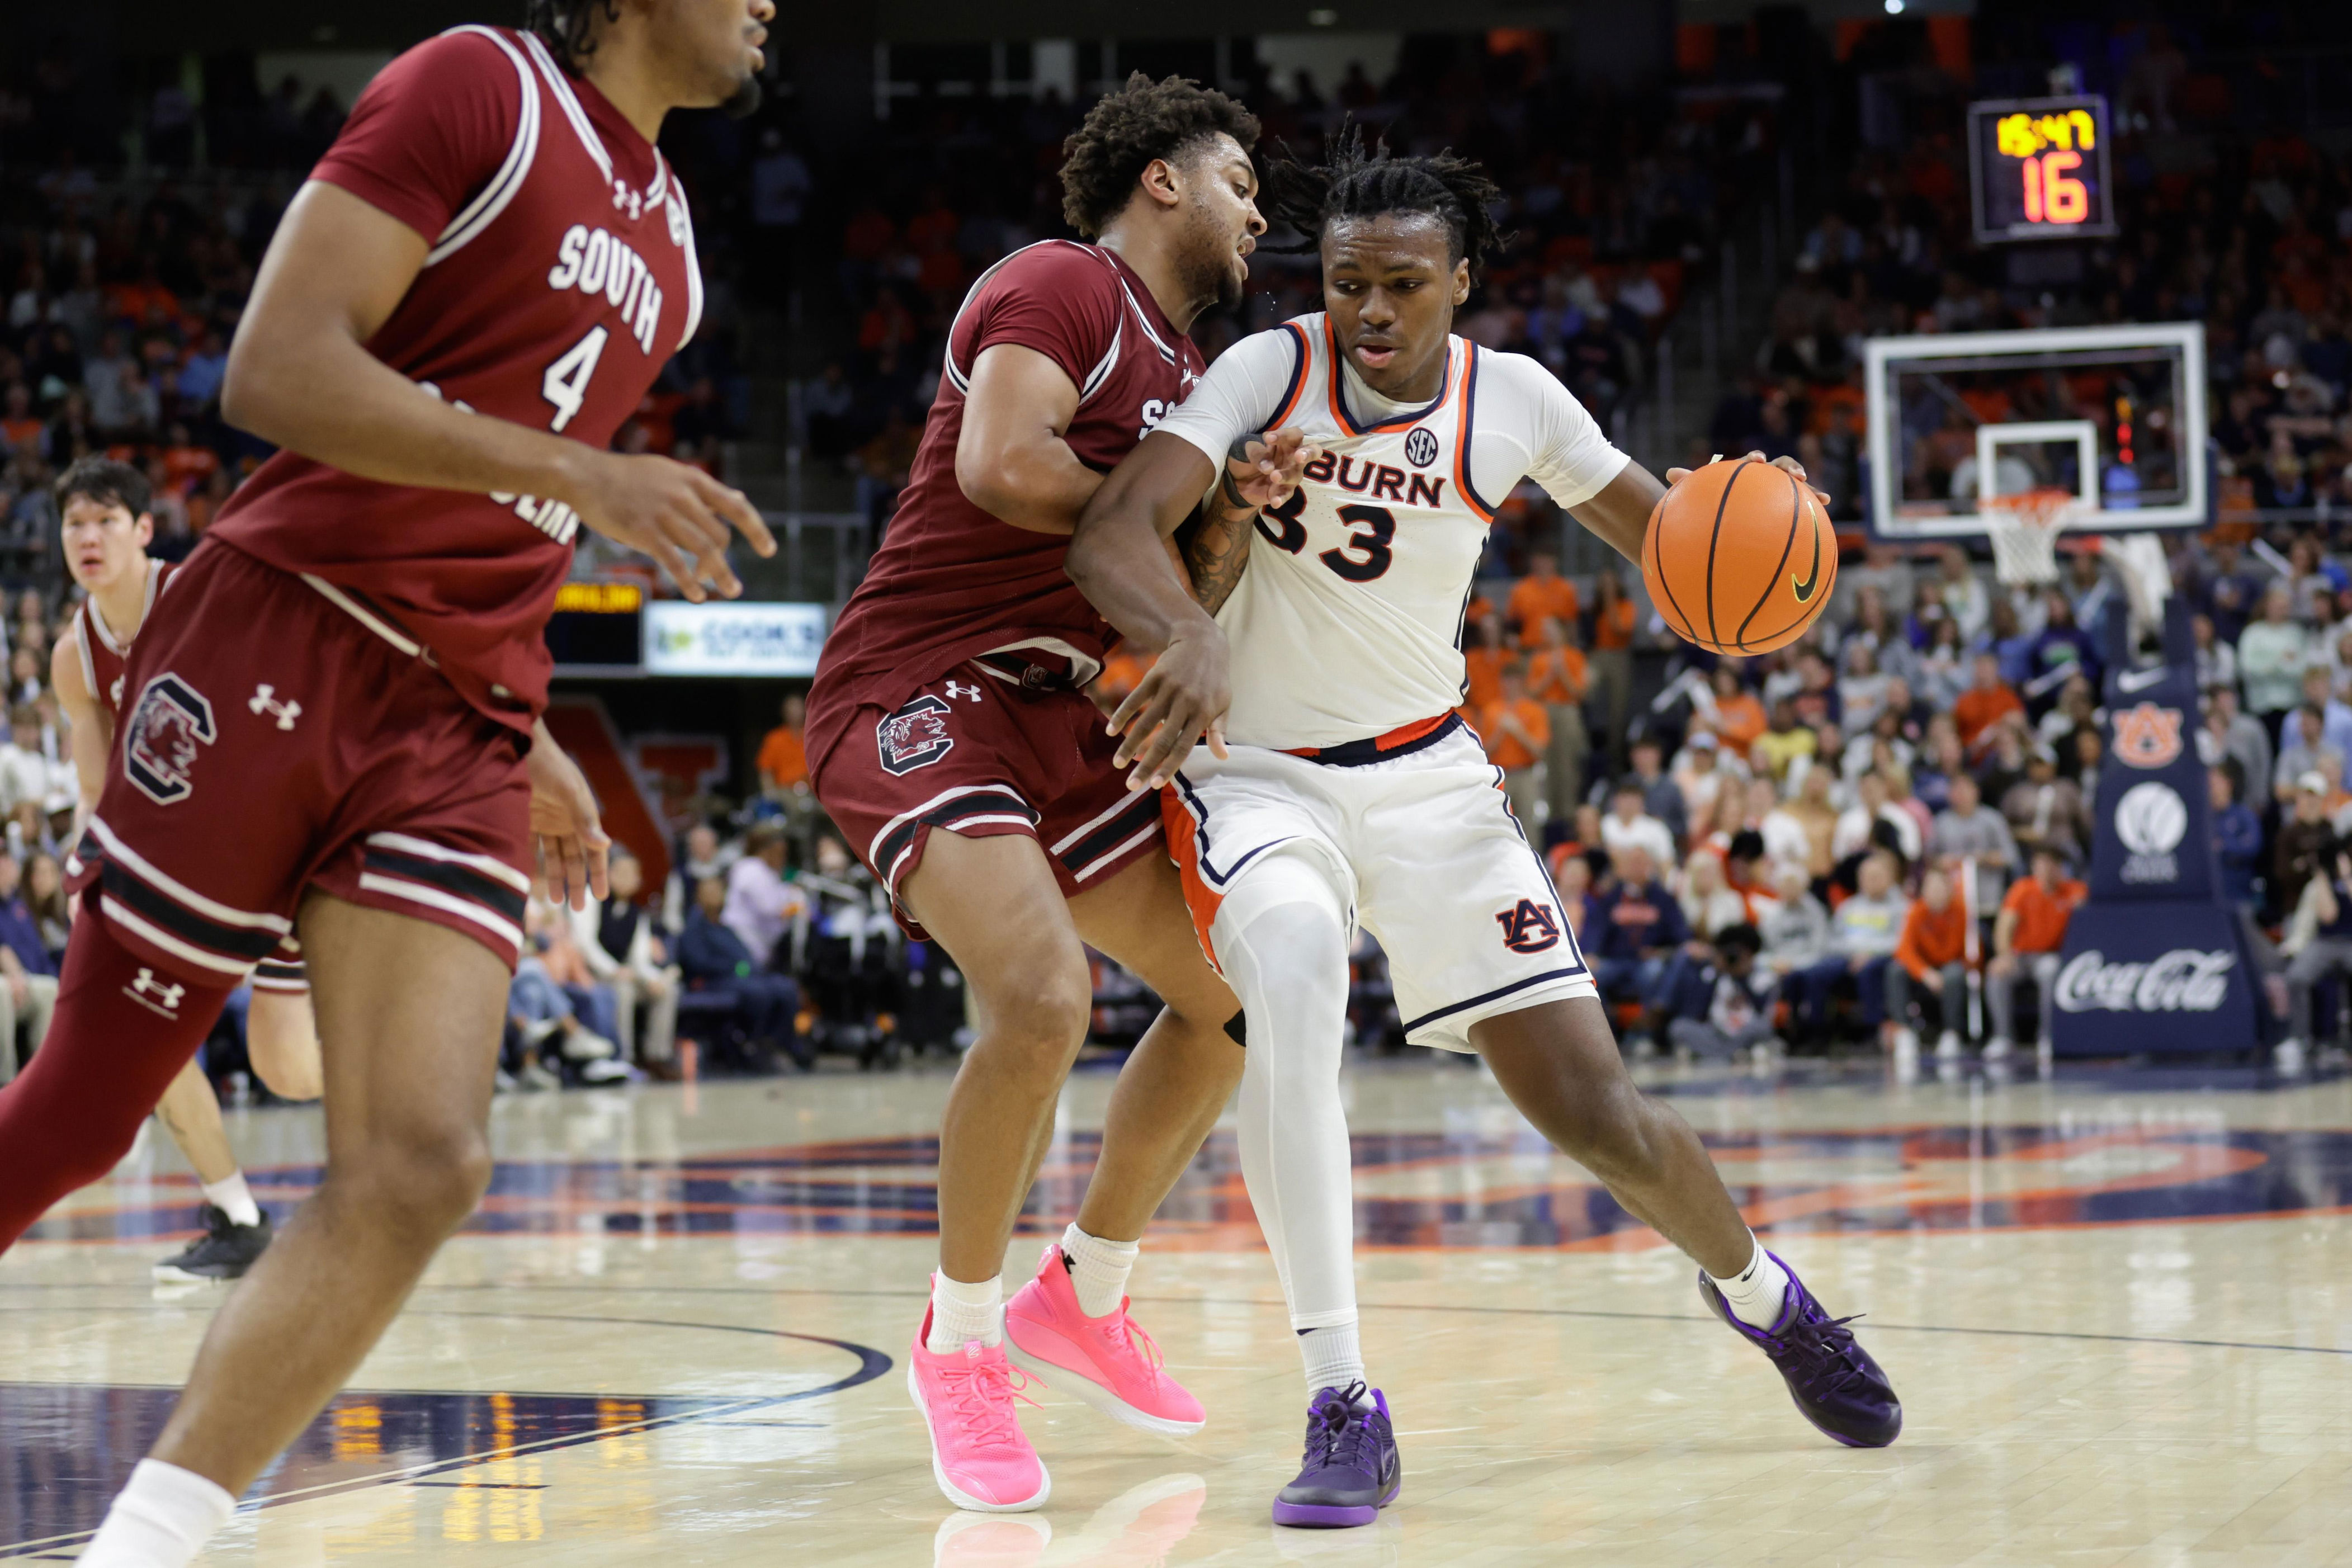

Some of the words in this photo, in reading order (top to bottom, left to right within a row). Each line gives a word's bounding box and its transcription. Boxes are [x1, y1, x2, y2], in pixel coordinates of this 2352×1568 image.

[2023, 150, 2088, 224] 16
[548, 224, 663, 356] SOUTH
[542, 324, 608, 433] 4
[1303, 449, 1446, 509] BURN
[1408, 429, 1437, 467] SEC
